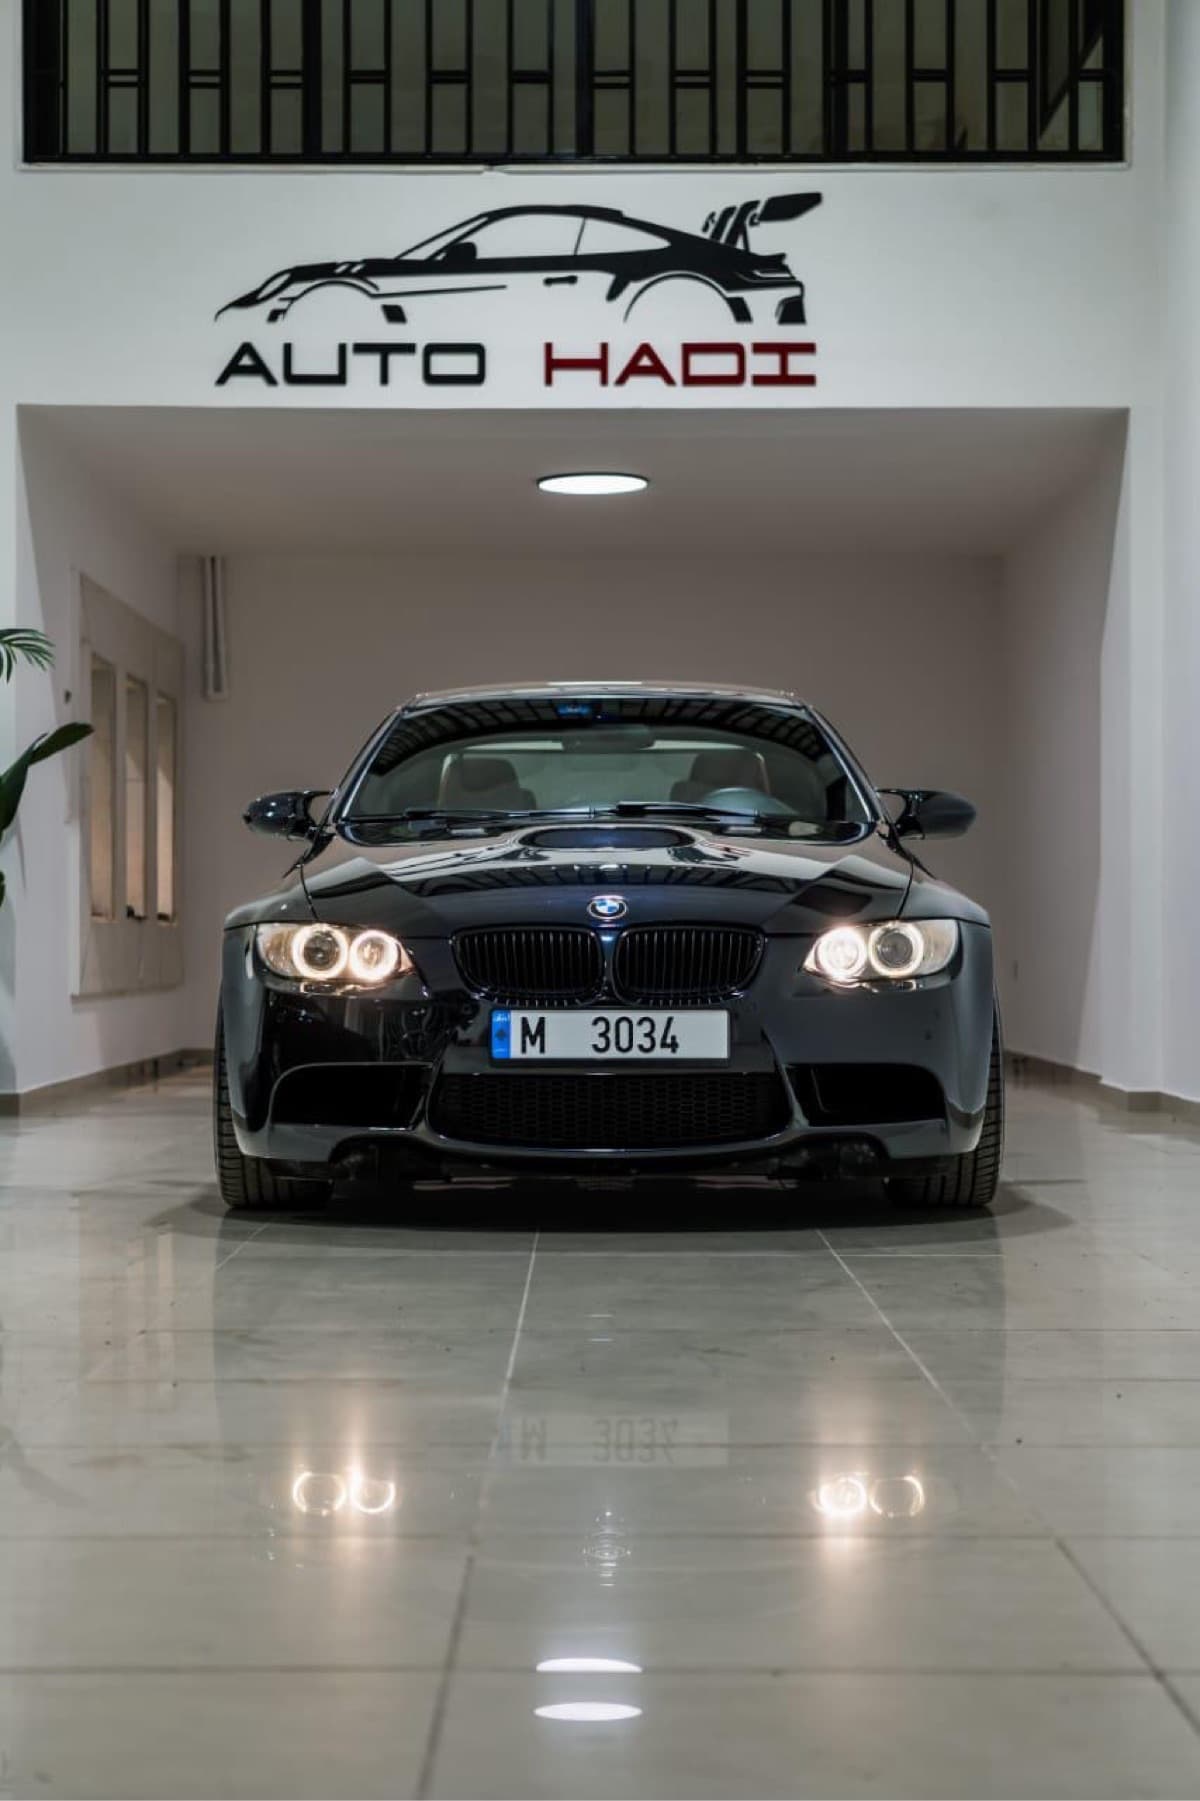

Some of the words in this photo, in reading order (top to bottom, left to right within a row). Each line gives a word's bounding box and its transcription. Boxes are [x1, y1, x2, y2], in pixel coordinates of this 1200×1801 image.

[215, 342, 486, 387] AUTO
[544, 342, 817, 387] HADI
[520, 1016, 546, 1055] M
[591, 1016, 679, 1055] 3034
